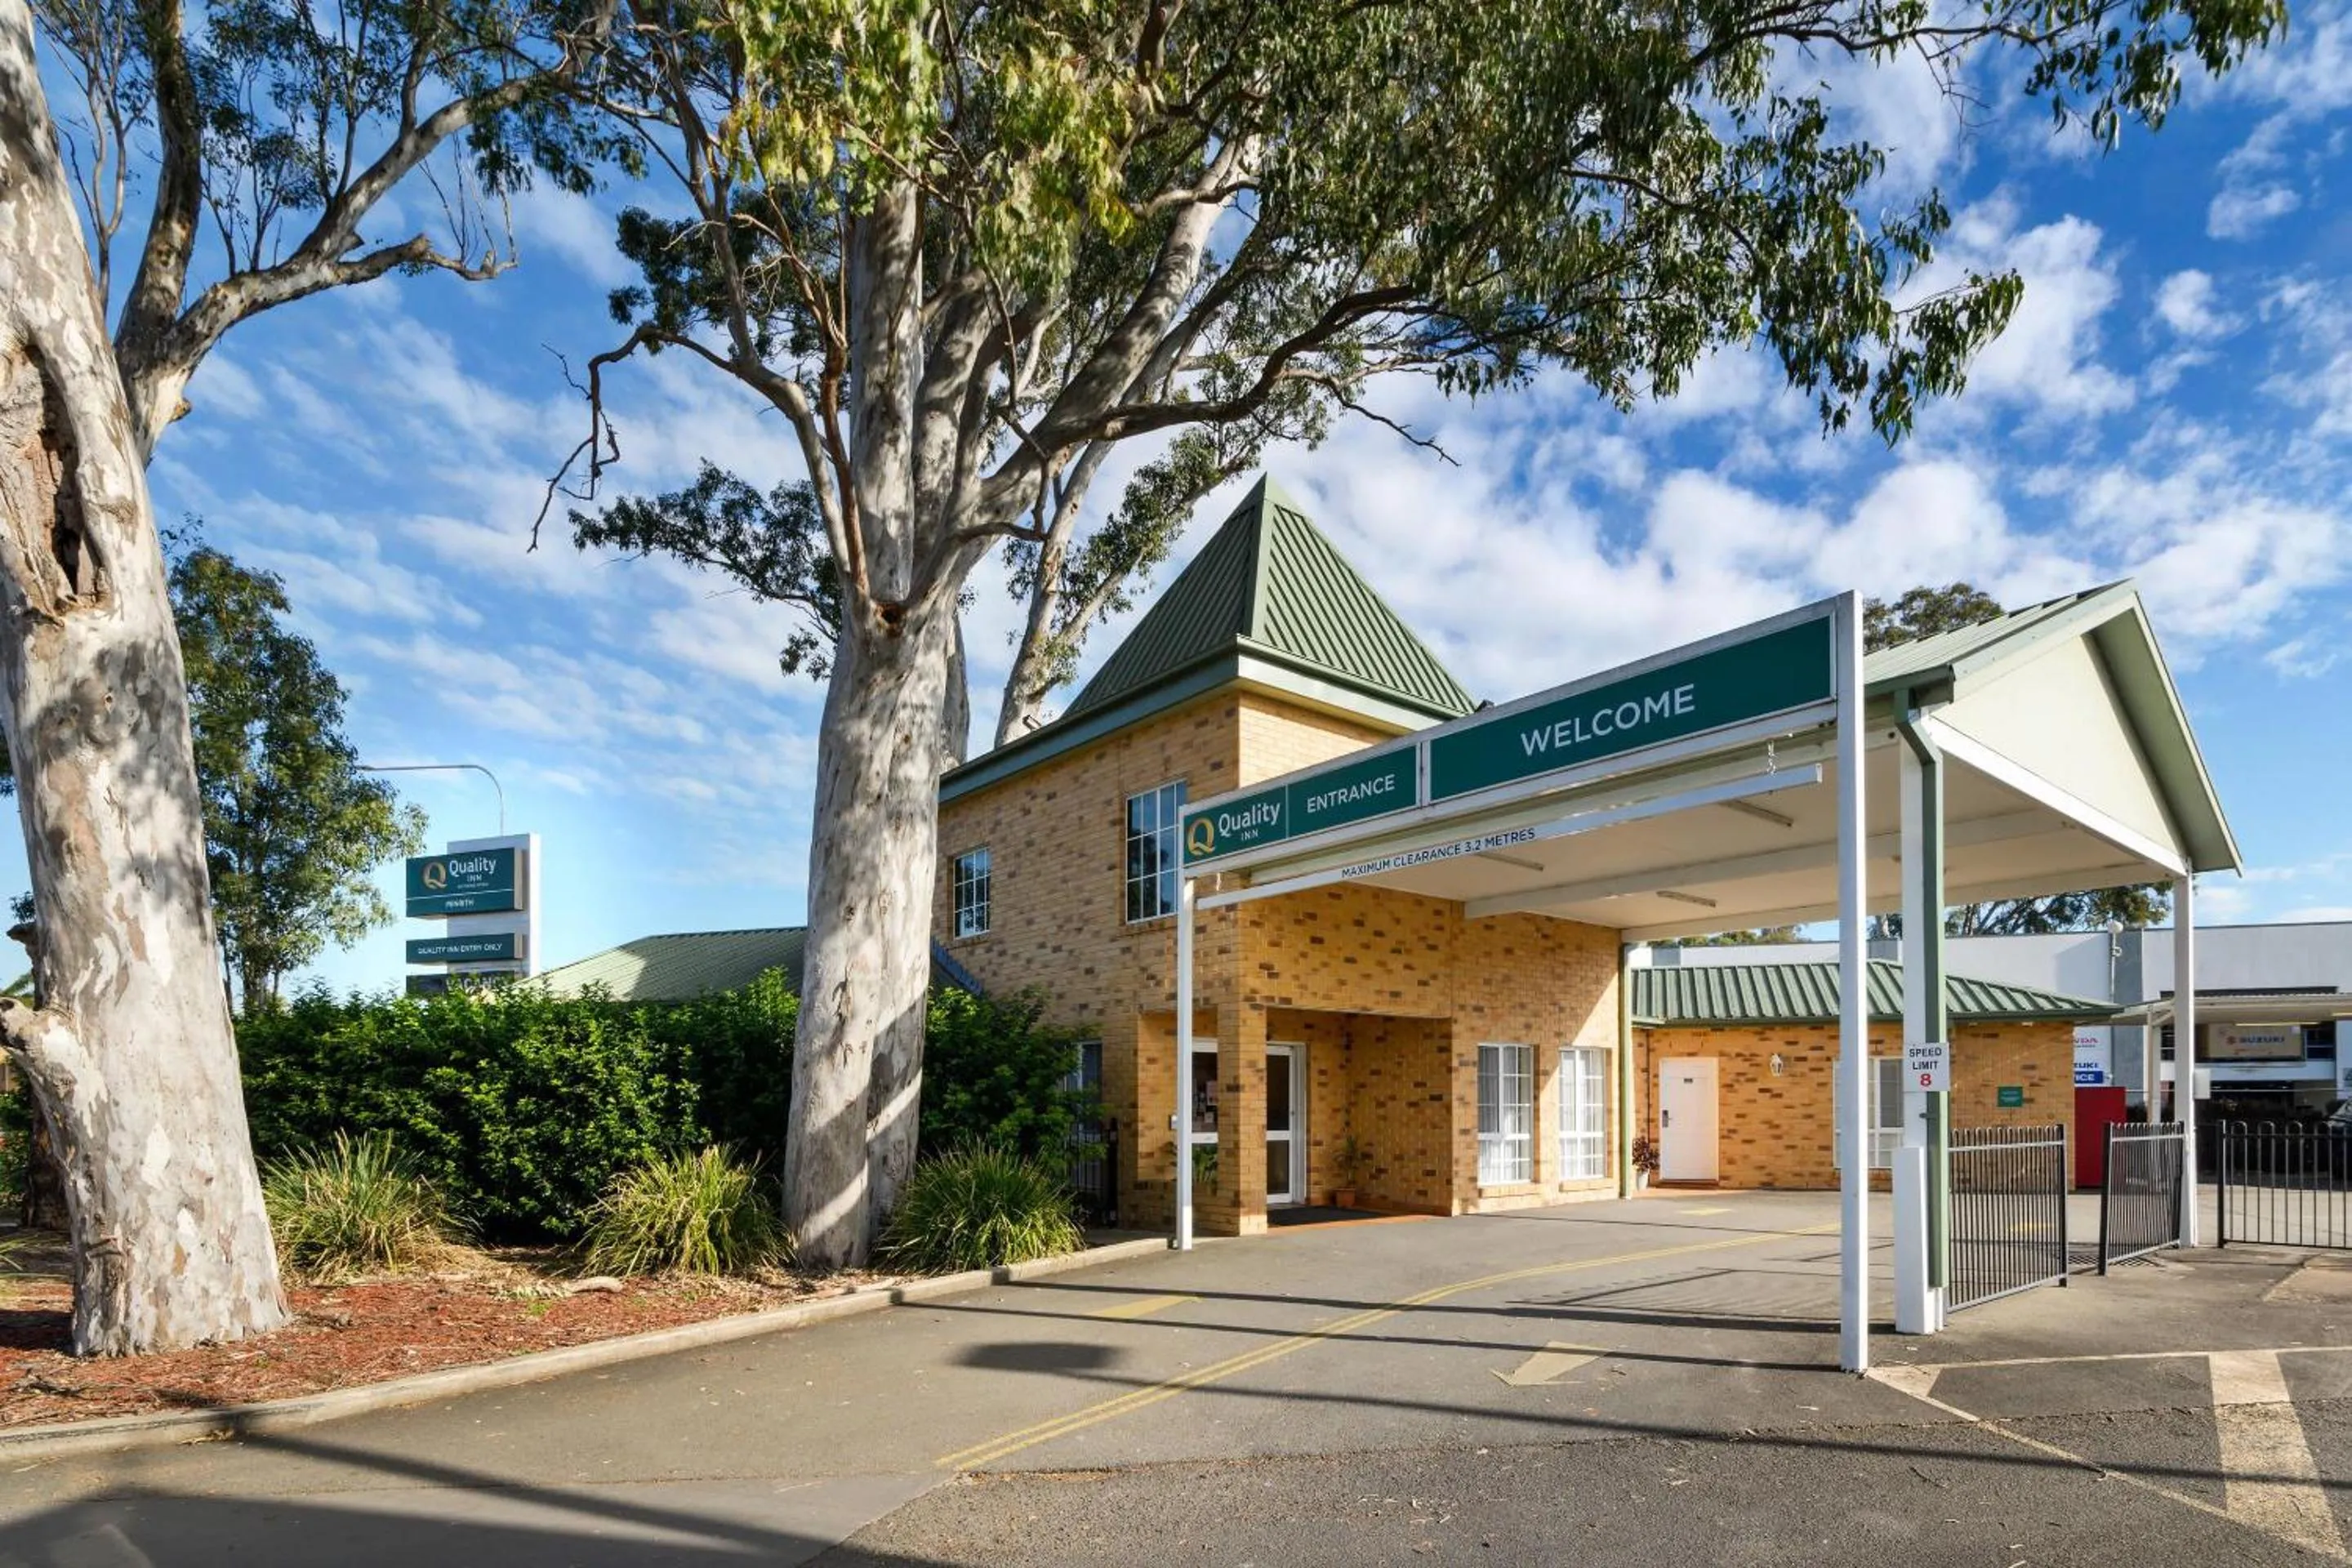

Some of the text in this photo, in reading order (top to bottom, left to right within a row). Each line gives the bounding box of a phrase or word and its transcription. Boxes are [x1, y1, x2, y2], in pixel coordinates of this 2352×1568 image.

[1520, 684, 1695, 757] WELCOME
[1306, 774, 1396, 813] ENTRANCE
[1187, 803, 1281, 856] Q Quality
[1241, 829, 1258, 841] INN
[1342, 827, 1535, 878] MAXIMUM CLEARANCE 3.2 METRES
[423, 858, 496, 889] Q Quality
[466, 874, 482, 882] INN
[483, 942, 503, 951] ONLY
[1909, 1047, 1942, 1058] SPEED
[1913, 1061, 1939, 1070] LIMIT
[1920, 1073, 1932, 1087] 8
